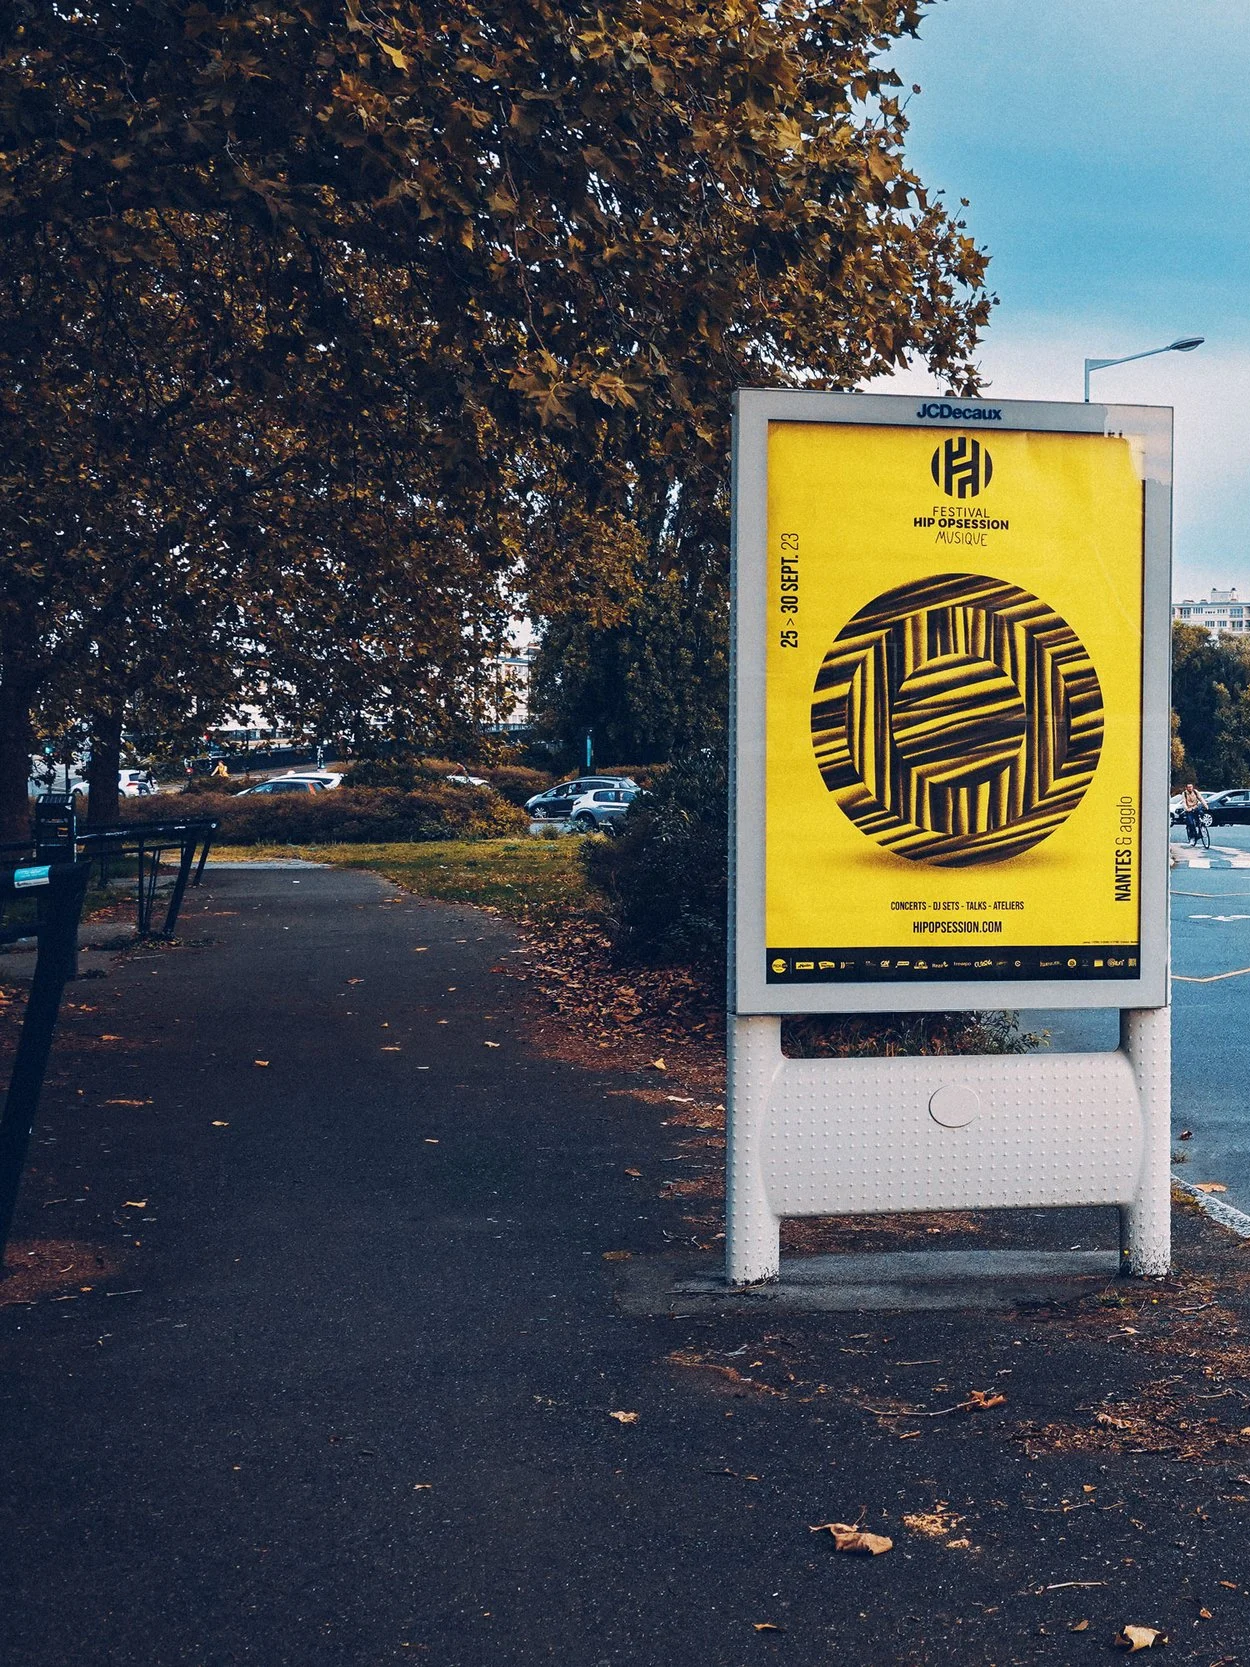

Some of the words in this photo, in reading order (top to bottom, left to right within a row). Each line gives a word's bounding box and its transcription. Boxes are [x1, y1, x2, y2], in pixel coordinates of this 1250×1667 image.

[917, 403, 1002, 420] JCDecaux
[933, 506, 990, 518] FESTIVAL
[913, 517, 936, 528] HIP
[938, 518, 1009, 530] OPSESSION
[780, 532, 799, 551] 23
[935, 531, 988, 547] MUSIQUE
[780, 554, 799, 592] SEPT.
[780, 595, 799, 614] 30
[780, 630, 799, 649] 25
[1116, 796, 1136, 833] agglo
[1114, 849, 1132, 902] NANTES
[890, 901, 927, 911] CONCERTS
[932, 901, 941, 911] DJ
[942, 901, 960, 911] SETS
[966, 901, 987, 911] TALKS
[993, 900, 1025, 911] ATELIERS
[912, 921, 1002, 933] HIPOPSESSION.COM
